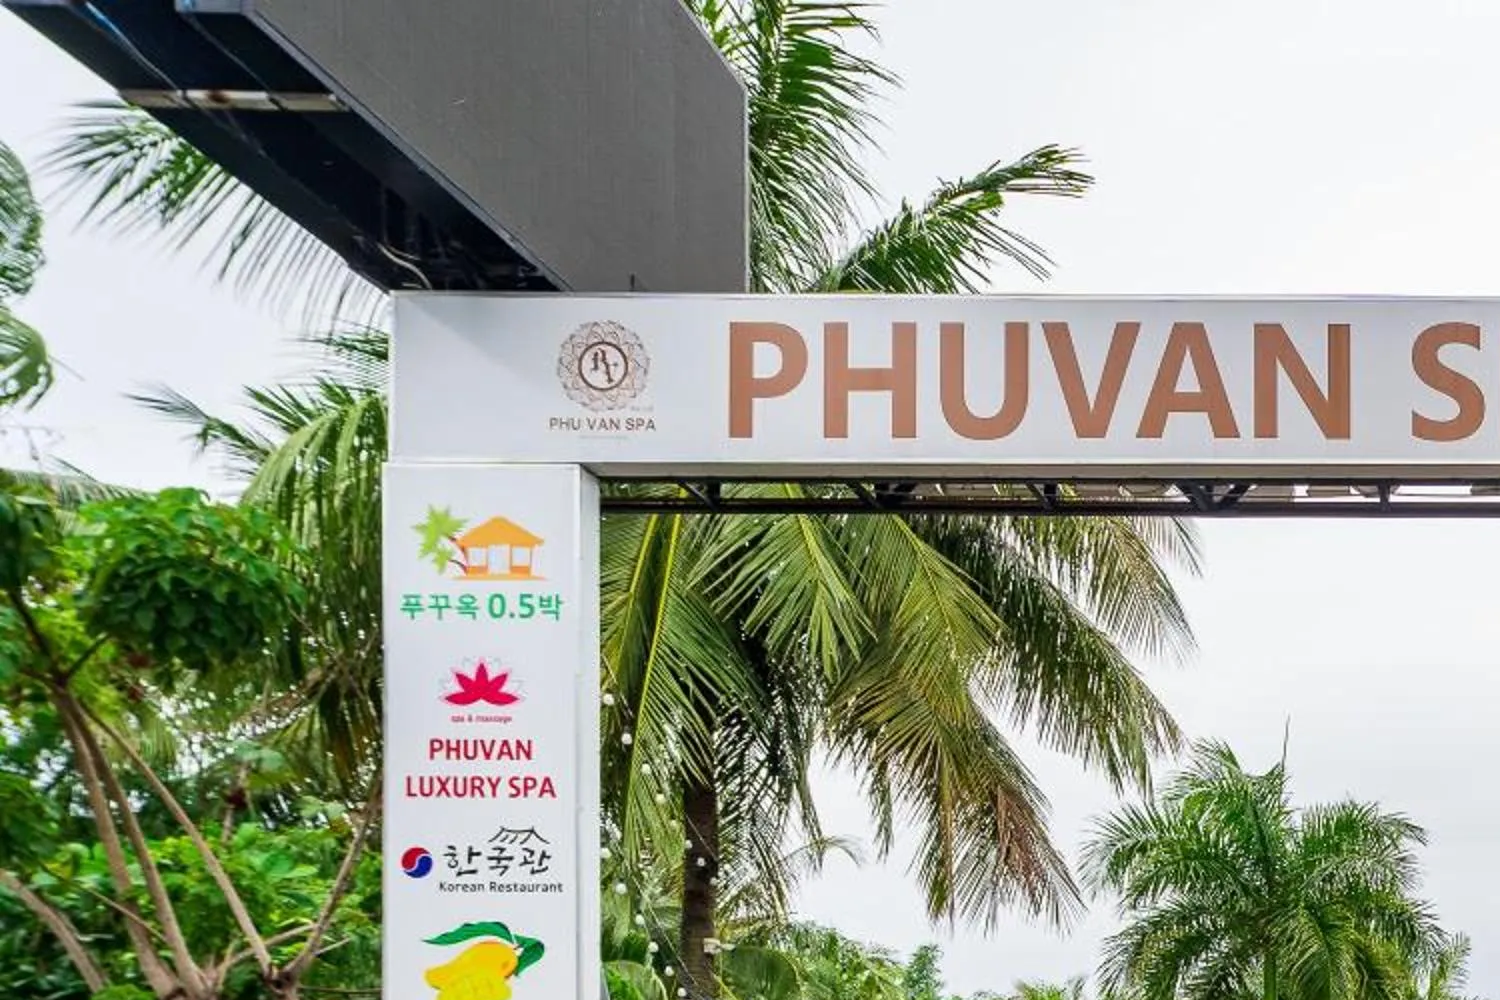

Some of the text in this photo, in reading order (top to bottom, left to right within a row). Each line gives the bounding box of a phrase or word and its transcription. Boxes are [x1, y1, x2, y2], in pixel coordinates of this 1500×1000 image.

[728, 321, 1351, 441] PHUVAN
[549, 417, 656, 431] PHU VAN SPA
[400, 593, 564, 621] 푸꾸옥 0.5박
[429, 738, 533, 761] PHUVAN
[405, 775, 557, 799] LUXURY SPA
[442, 845, 552, 877] 한국관
[439, 881, 564, 894] Korean Restaurant
